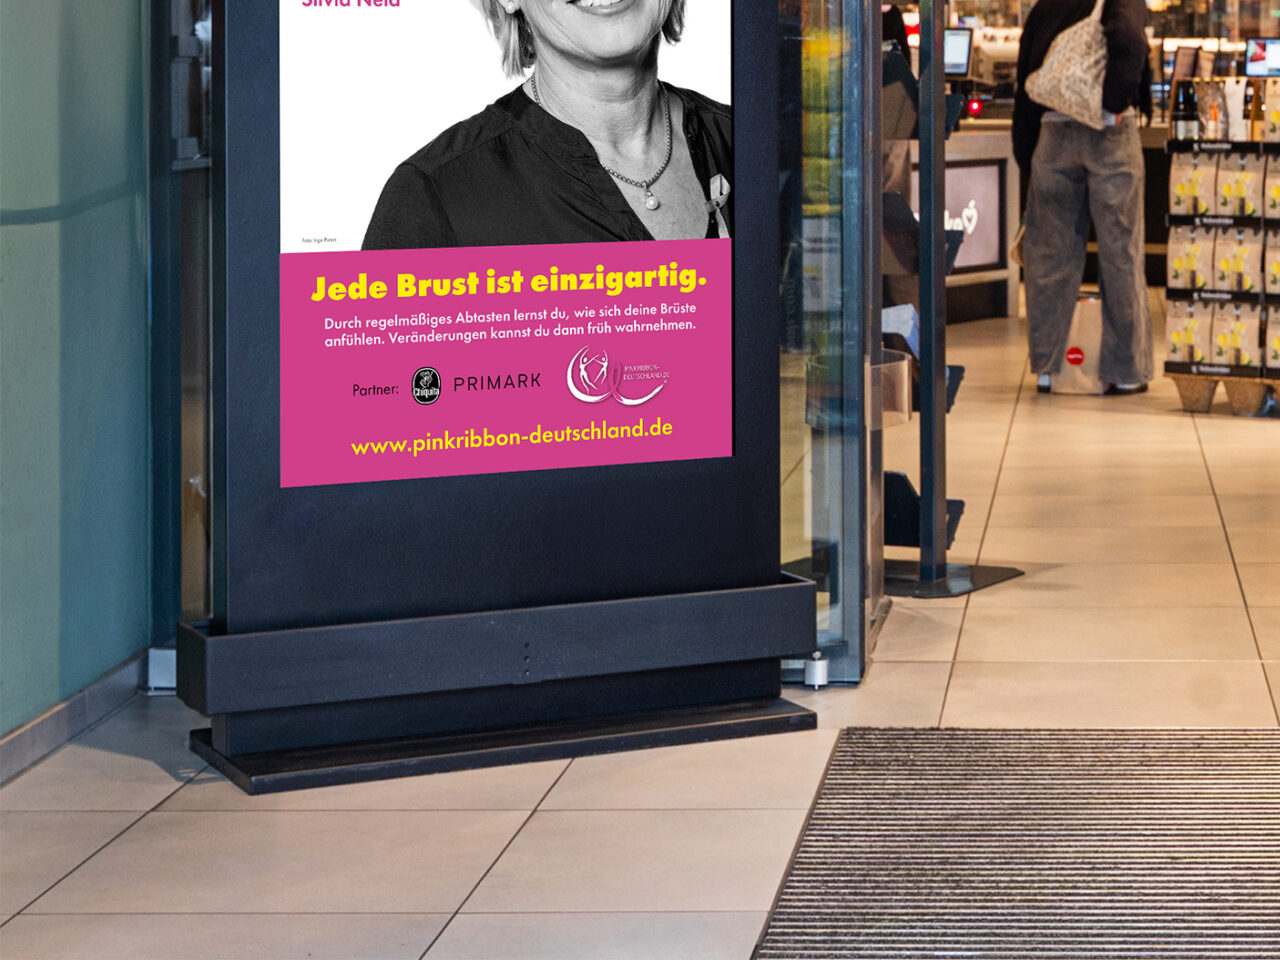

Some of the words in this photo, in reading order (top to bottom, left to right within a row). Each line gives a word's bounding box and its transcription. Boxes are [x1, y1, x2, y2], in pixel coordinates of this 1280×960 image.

[311, 273, 387, 301] Jede
[398, 272, 479, 297] Brust
[487, 269, 523, 293] ist
[531, 262, 706, 295] einzigartig.
[325, 316, 361, 329] Durch
[366, 313, 452, 329] regelmäßiges
[456, 311, 510, 323] Abtasten
[514, 309, 547, 320] lernst
[551, 308, 569, 320] du,
[574, 307, 595, 317] wie
[599, 305, 621, 317] sich
[624, 304, 657, 315] deine
[661, 303, 696, 314] Brüste
[325, 333, 384, 347] anfühlen.
[389, 327, 486, 343] Veränderungen
[491, 327, 531, 338] kannst
[534, 325, 549, 336] du
[553, 323, 584, 335] dann
[587, 321, 611, 334] früh
[615, 319, 695, 332] wahrnehmen.
[353, 384, 398, 396] Partner:
[454, 373, 540, 392] PRIMARK
[351, 417, 672, 456] www.pinkribbon-deutschland.de
